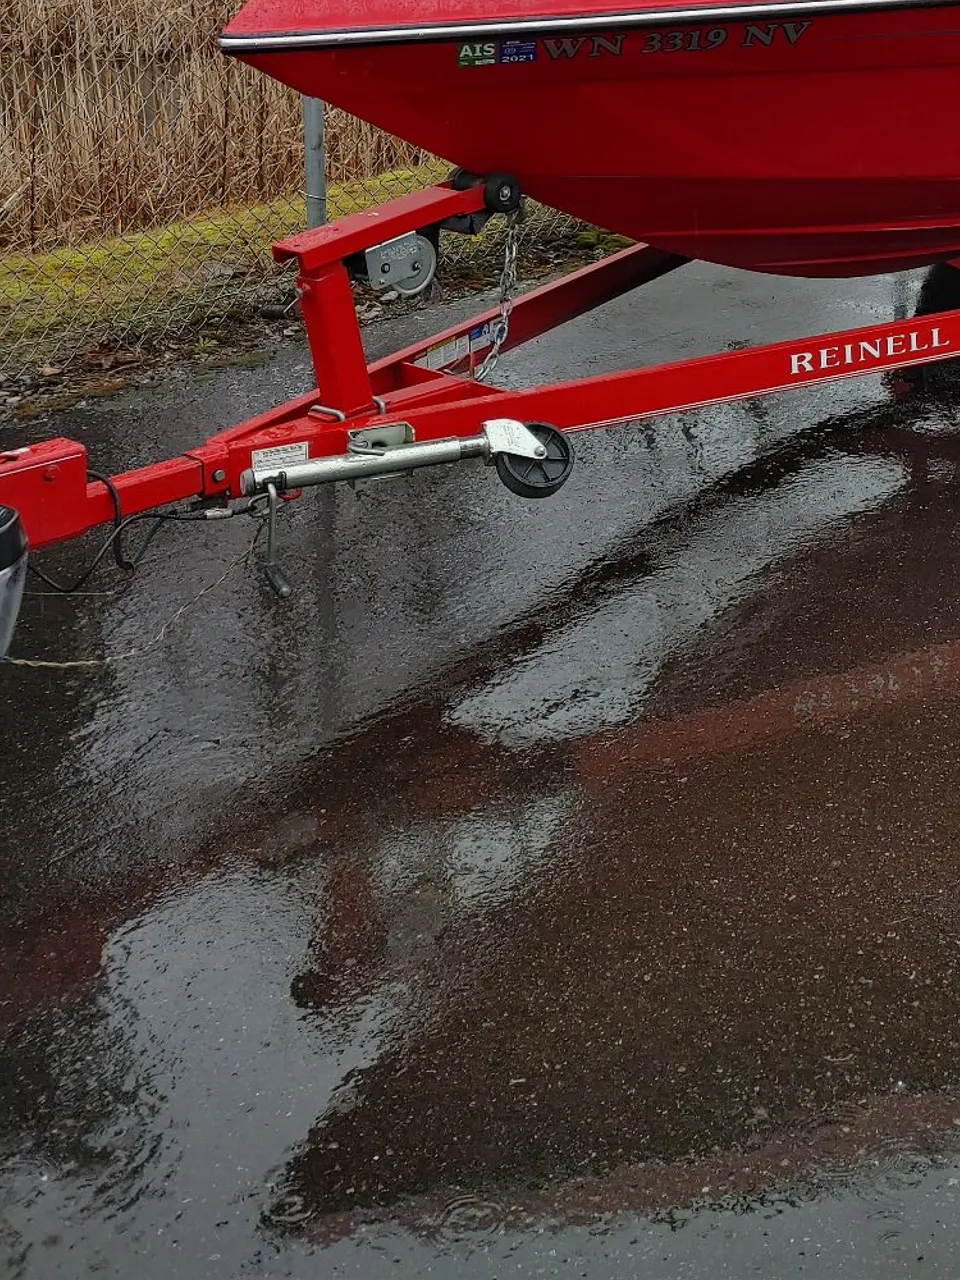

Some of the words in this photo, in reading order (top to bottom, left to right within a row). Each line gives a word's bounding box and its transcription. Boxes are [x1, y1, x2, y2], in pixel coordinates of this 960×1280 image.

[460, 43, 496, 58] AIS
[543, 34, 626, 59] WN
[641, 28, 728, 53] 3319
[741, 21, 812, 47] NV
[501, 54, 534, 63] 2021
[790, 327, 950, 375] REINELL
